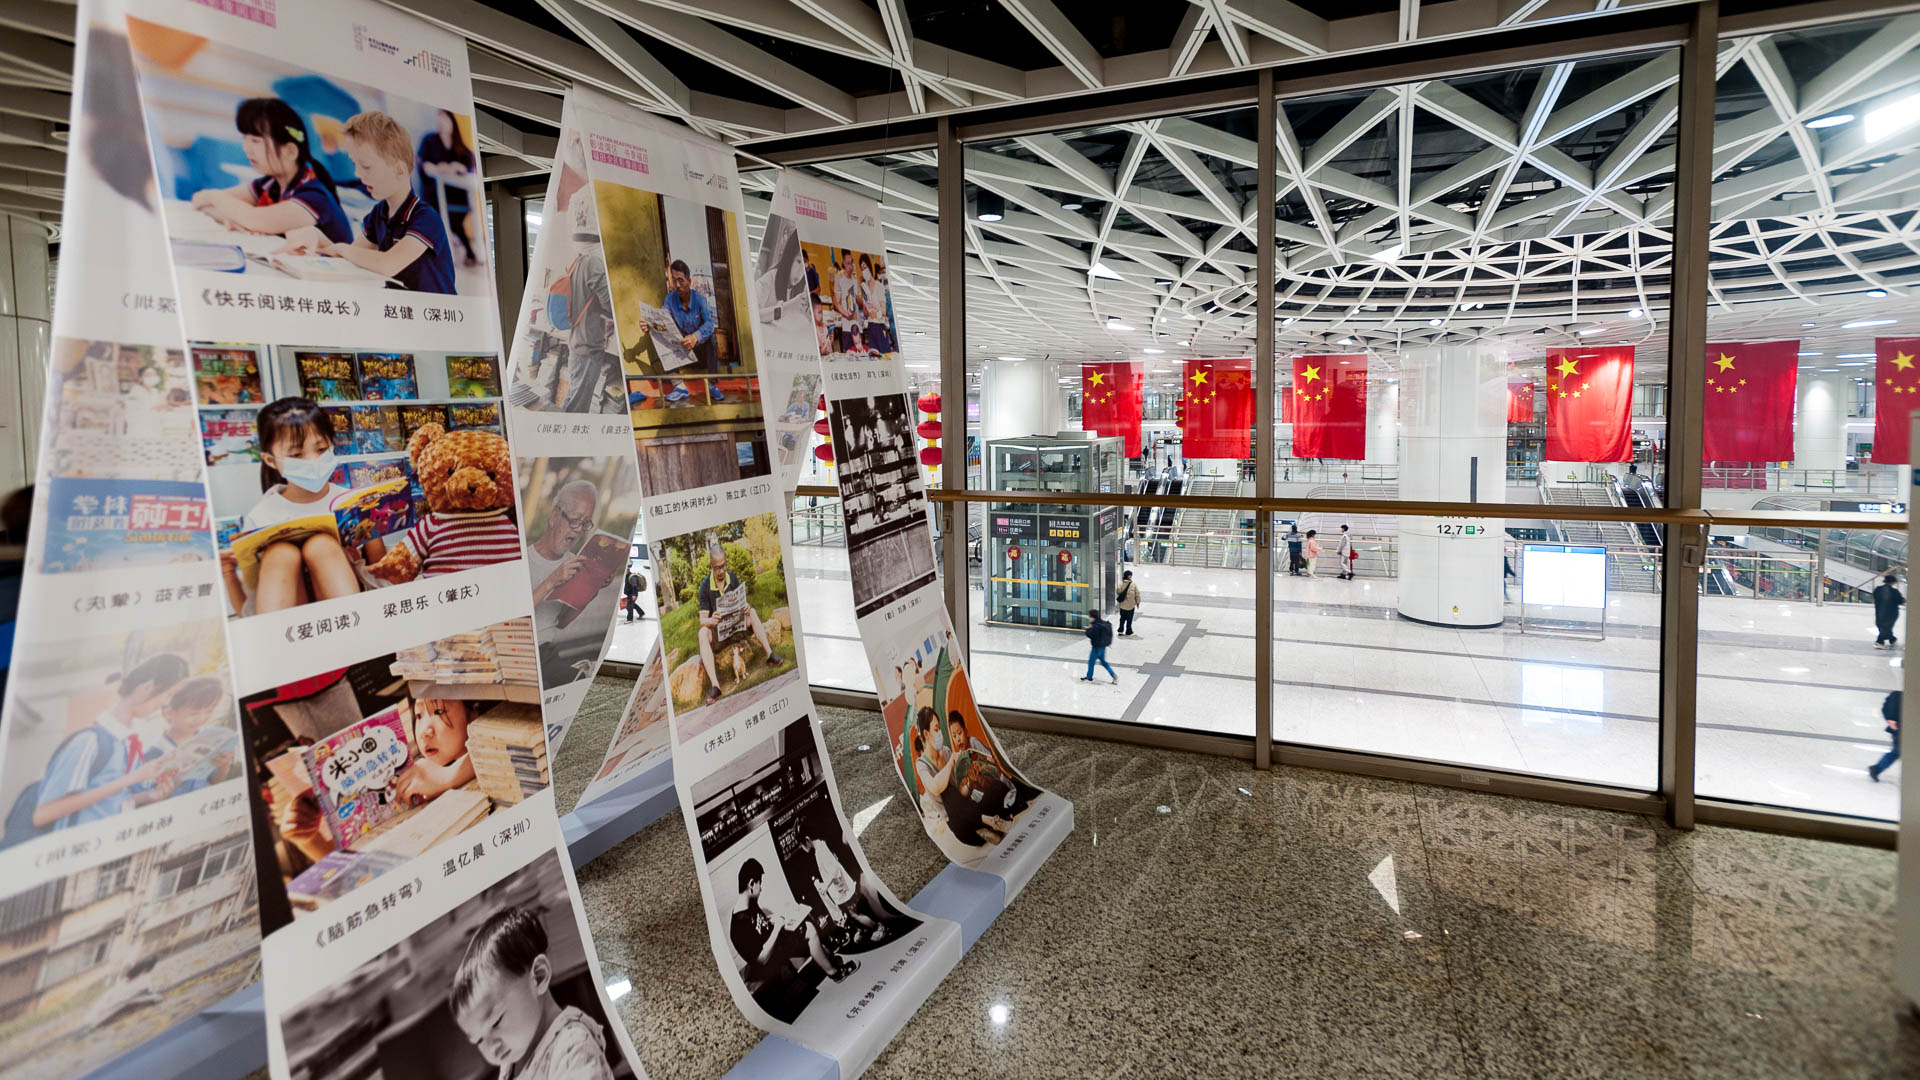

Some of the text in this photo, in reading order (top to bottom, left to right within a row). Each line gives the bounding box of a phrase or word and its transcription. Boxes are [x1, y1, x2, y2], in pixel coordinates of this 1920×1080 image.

[200, 288, 363, 318] 《快乐阅读伴成长》
[648, 493, 718, 517] 《船工的休闲时光》
[284, 610, 361, 643] 《爱阅读》
[315, 876, 424, 949] 《脑筋急转弯》
